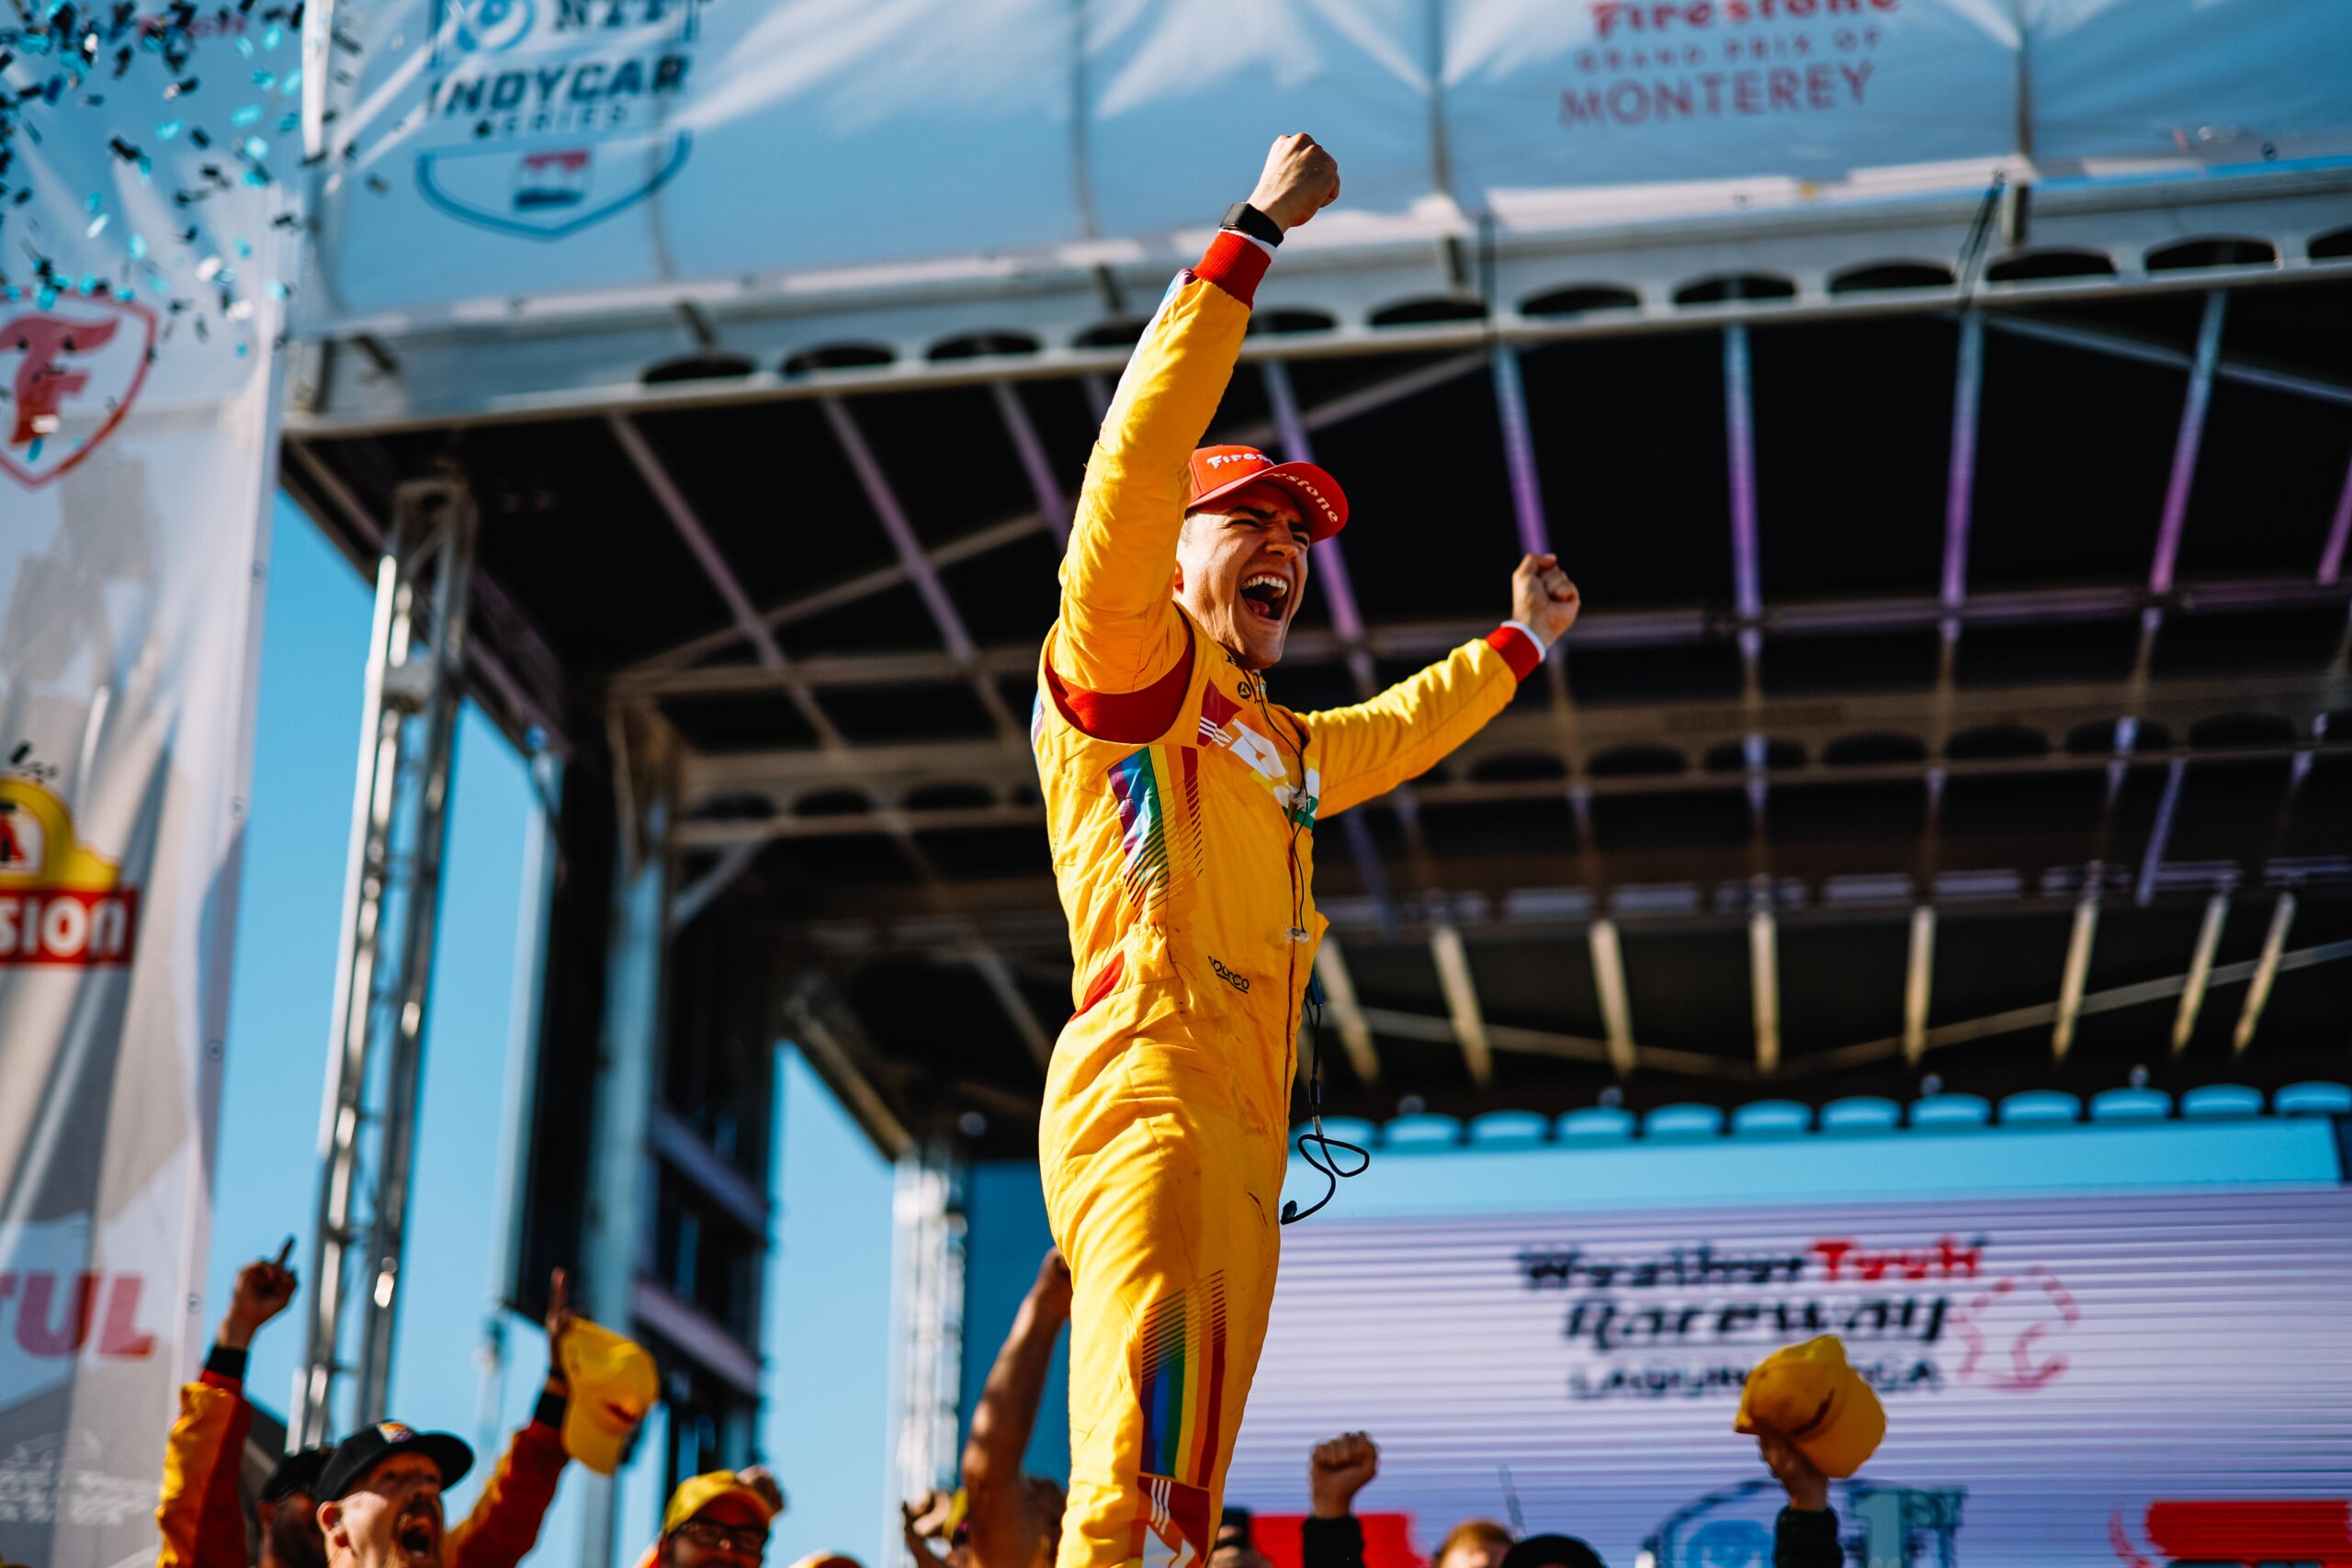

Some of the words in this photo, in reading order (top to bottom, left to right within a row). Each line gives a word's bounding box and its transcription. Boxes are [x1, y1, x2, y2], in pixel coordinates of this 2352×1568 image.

[429, 55, 691, 115] INDYCAR
[1559, 61, 1875, 126] MONTEREY
[1514, 1236, 1982, 1290] WeatherTech
[1565, 1298, 1950, 1351] Raceway
